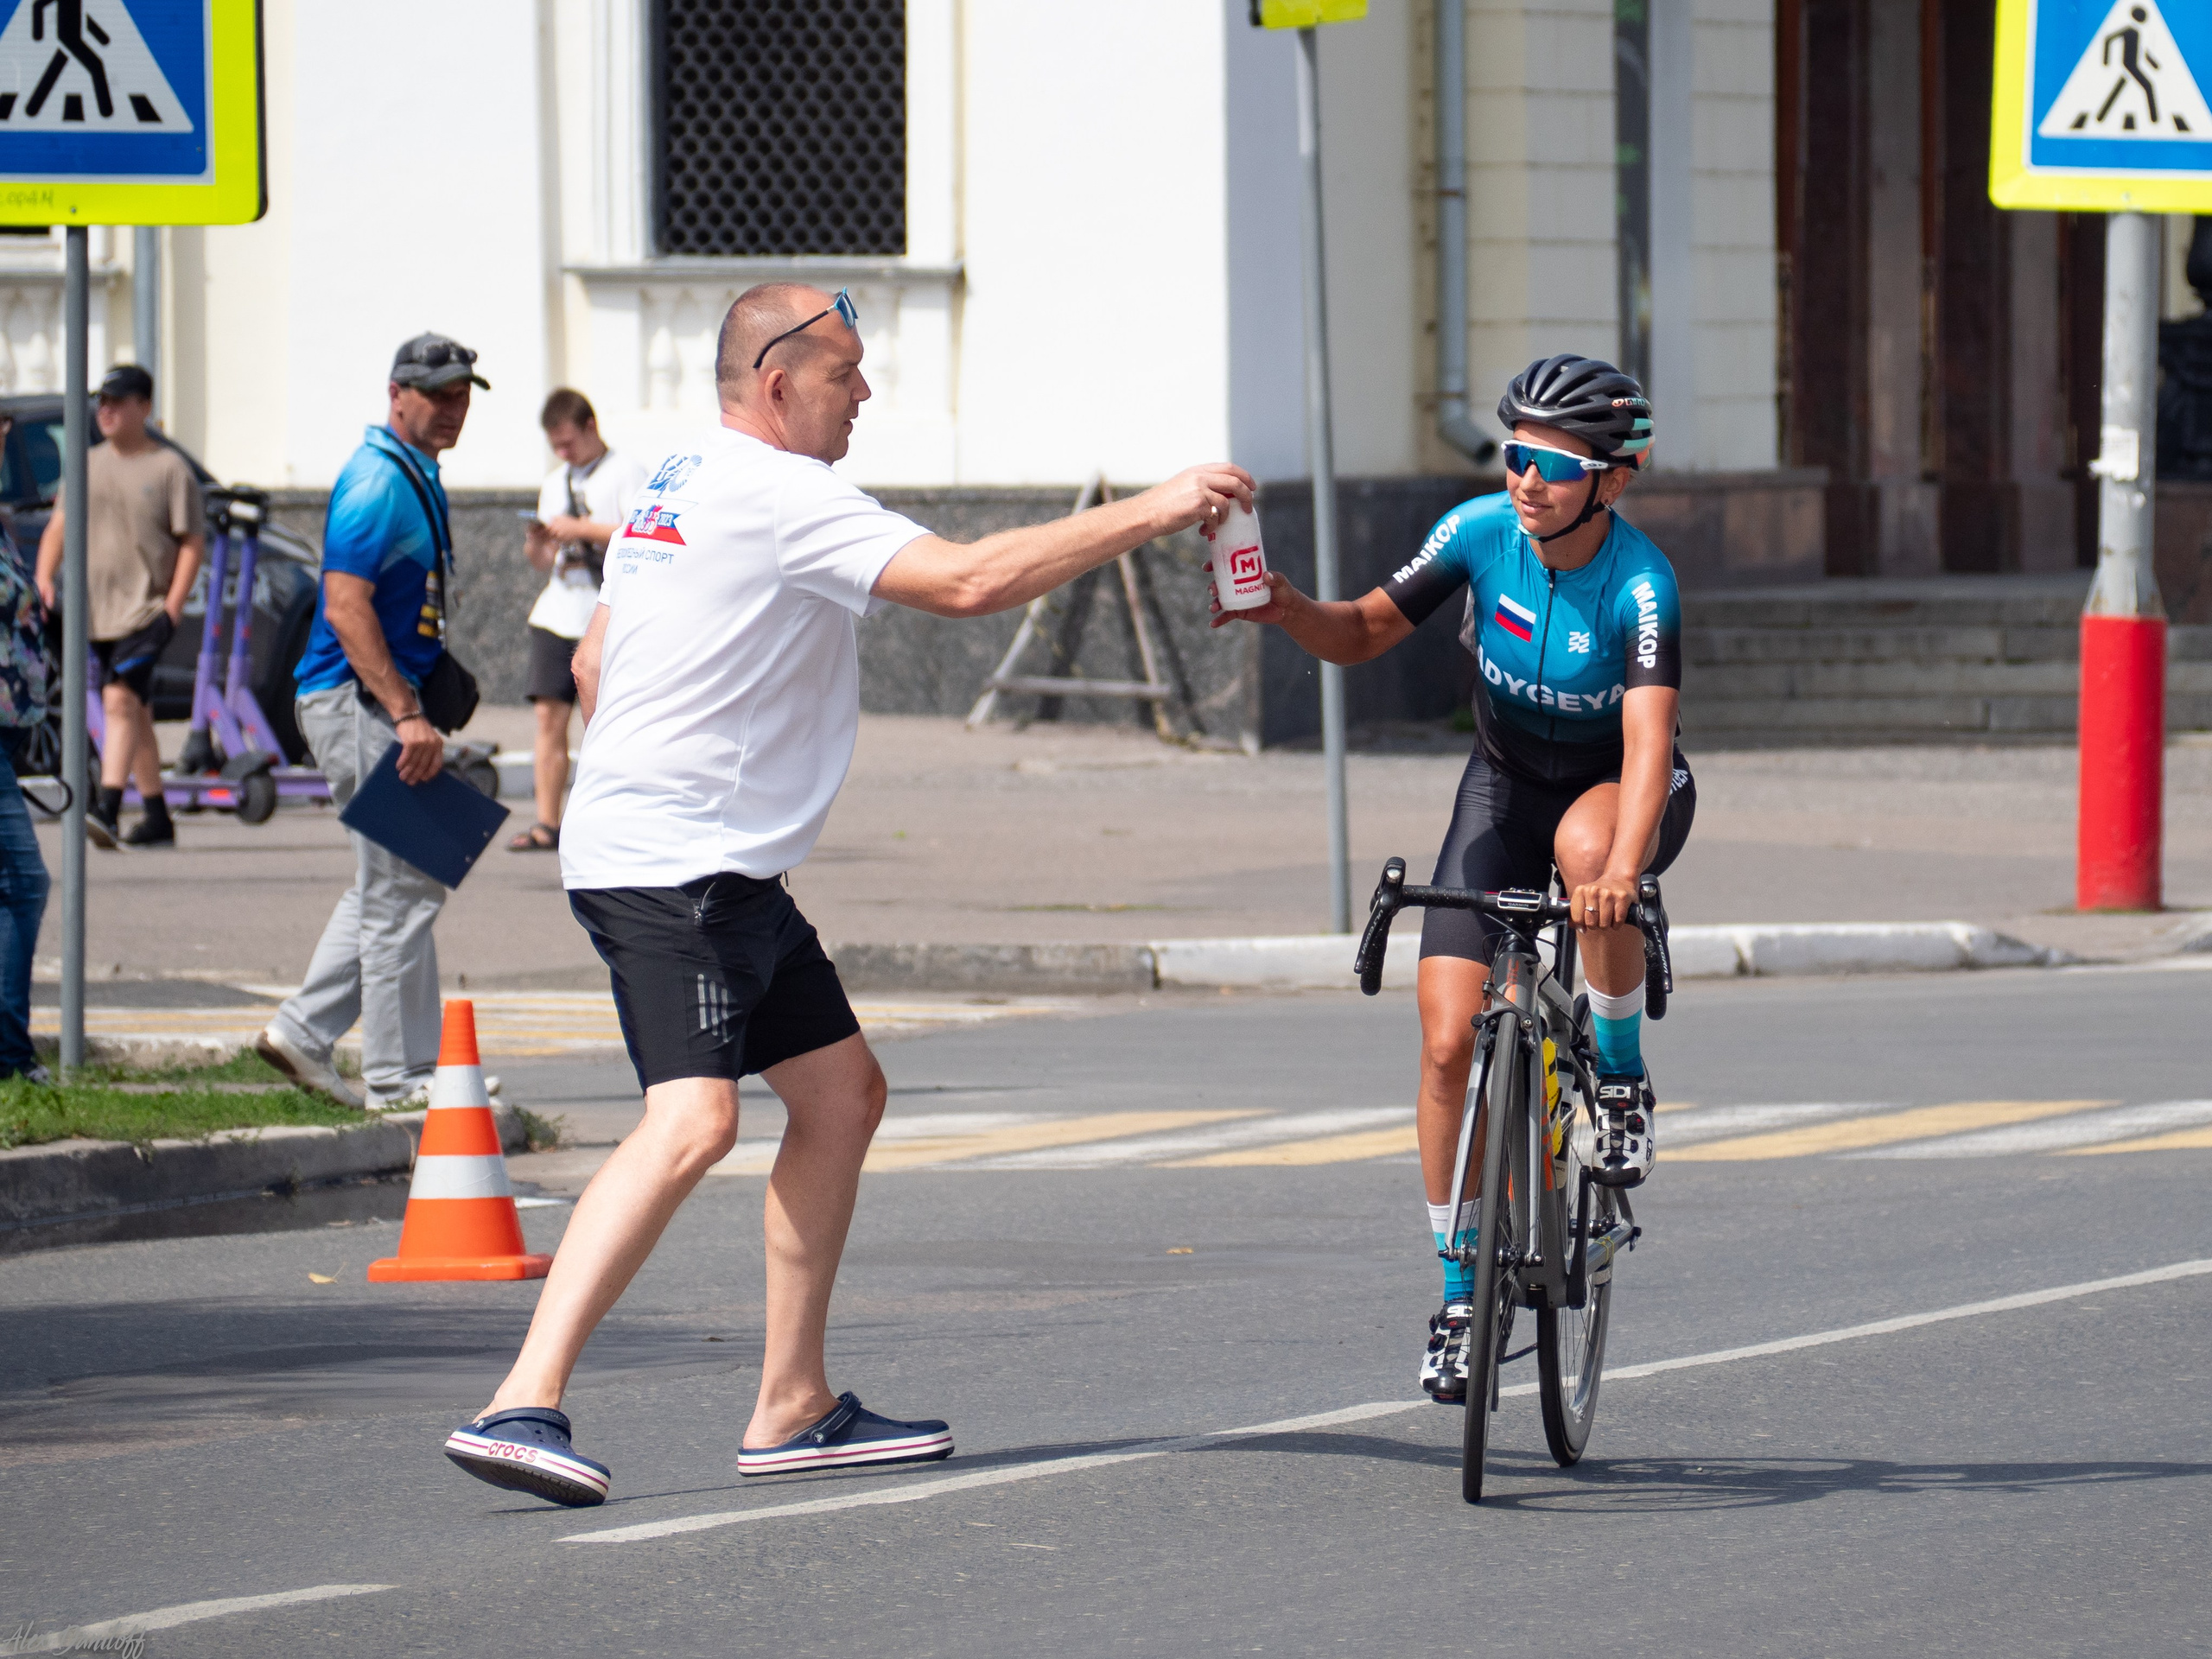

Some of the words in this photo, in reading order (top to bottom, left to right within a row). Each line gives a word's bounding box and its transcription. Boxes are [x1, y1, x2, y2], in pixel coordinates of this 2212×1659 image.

[645, 550, 674, 564] СПОРТ
[1392, 515, 1460, 583] MAIKOP
[1235, 583, 1267, 596] MAGNIT
[1631, 582, 1658, 669] MAIKOP
[1652, 925, 1669, 974] ULTEGRA
[1599, 1085, 1631, 1100] SIDI
[1446, 1305, 1472, 1319] SID
[488, 1442, 538, 1463] crocs
